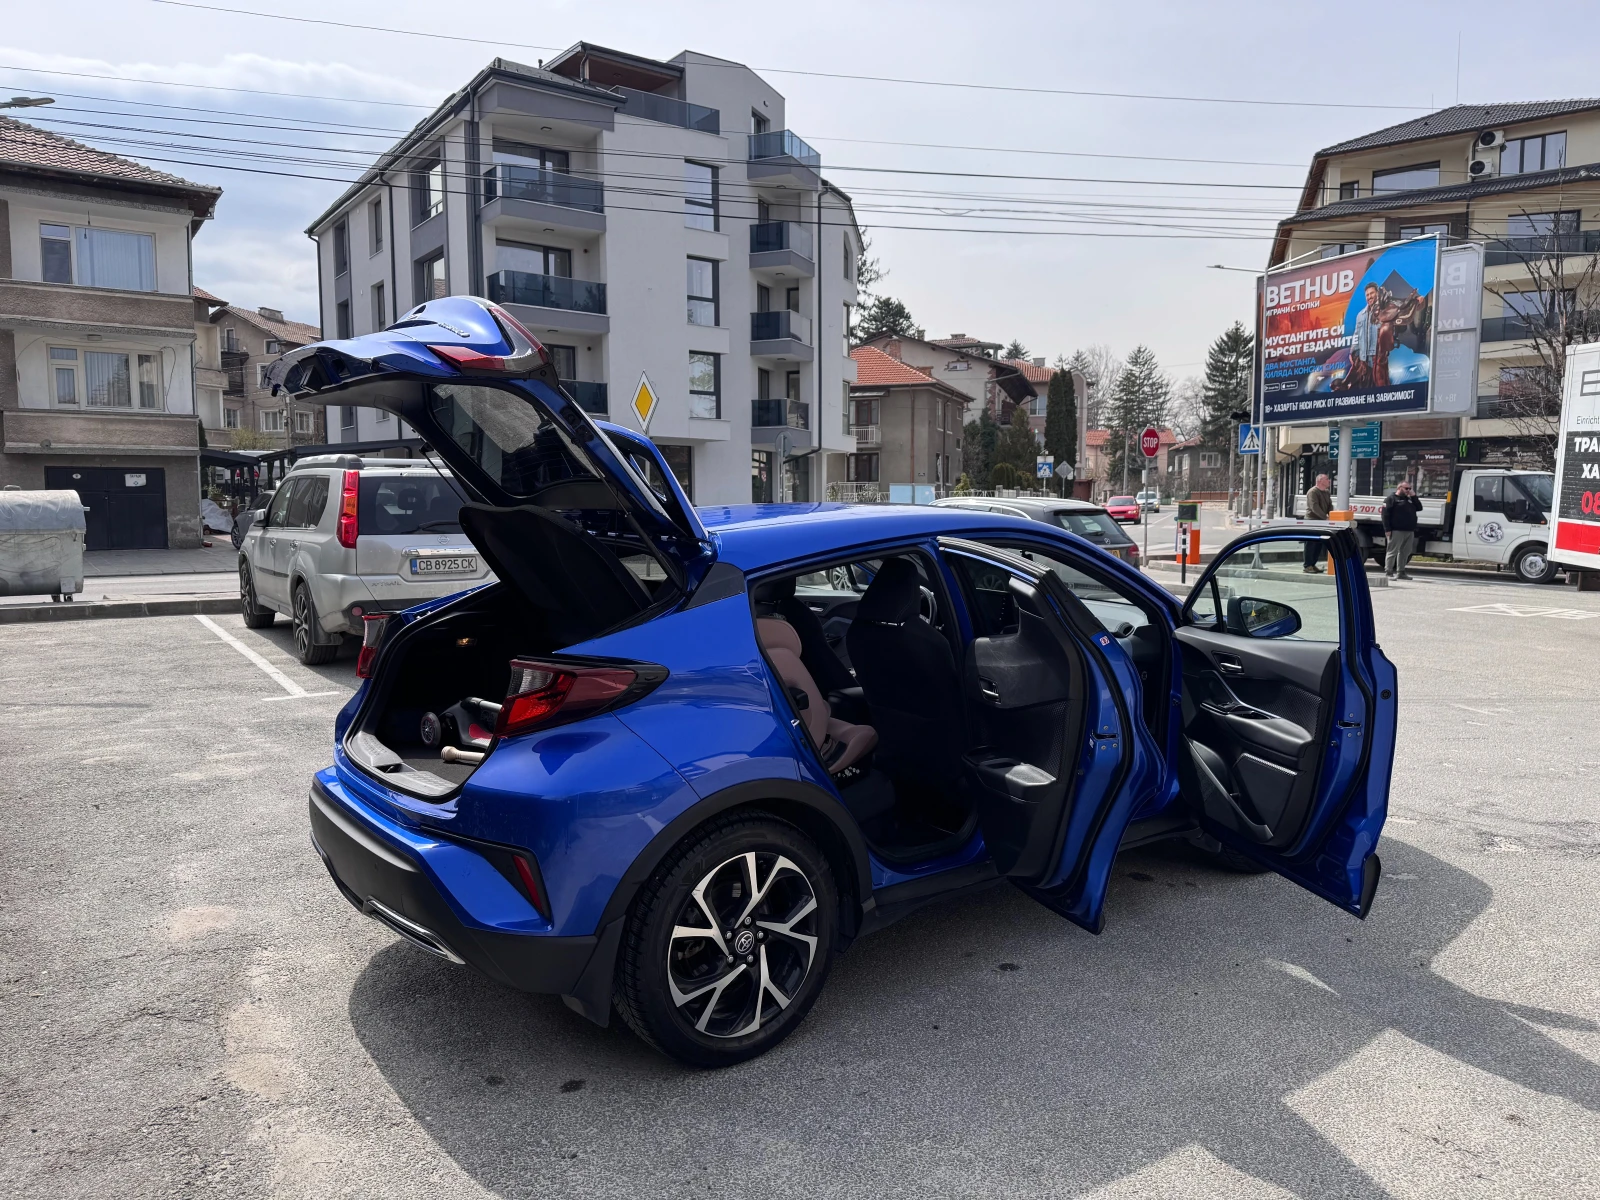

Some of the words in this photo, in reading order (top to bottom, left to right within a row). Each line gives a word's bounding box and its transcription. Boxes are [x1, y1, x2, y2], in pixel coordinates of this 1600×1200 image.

[1266, 269, 1355, 308] BETHUB
[1265, 307, 1291, 317] ИГРАЧИ
[1296, 300, 1321, 311] ТОПКИ
[1265, 327, 1329, 347] МУСТАНГИТЕ
[1330, 325, 1345, 336] СИ
[1264, 344, 1303, 359] ТЪРСЯТ
[1303, 334, 1359, 353] ЕЗДАЧИТЕ
[1264, 368, 1293, 379] ХИЛЯДА
[1293, 364, 1324, 376] КОНСКИ
[1325, 361, 1346, 371] СИЛИ
[1265, 362, 1284, 371] ДВА
[1284, 357, 1316, 369] МУСТАНГА
[1265, 405, 1273, 413] 18+
[1273, 402, 1298, 412] ХАЗАРТЪТ
[1299, 400, 1312, 410] НОСИ
[1313, 399, 1327, 409] РИСК
[1327, 398, 1335, 407] ОТ
[1335, 395, 1367, 406] РАЗВИВАНЕ
[1367, 394, 1376, 403] НА
[1376, 389, 1416, 402] ЗАВИСИМОСТ
[1143, 437, 1159, 448] STOP
[1574, 437, 1600, 453] ТРА
[1360, 505, 1376, 513] 707
[419, 560, 433, 571] CB
[434, 559, 460, 570] 8925
[461, 558, 475, 569] CK
